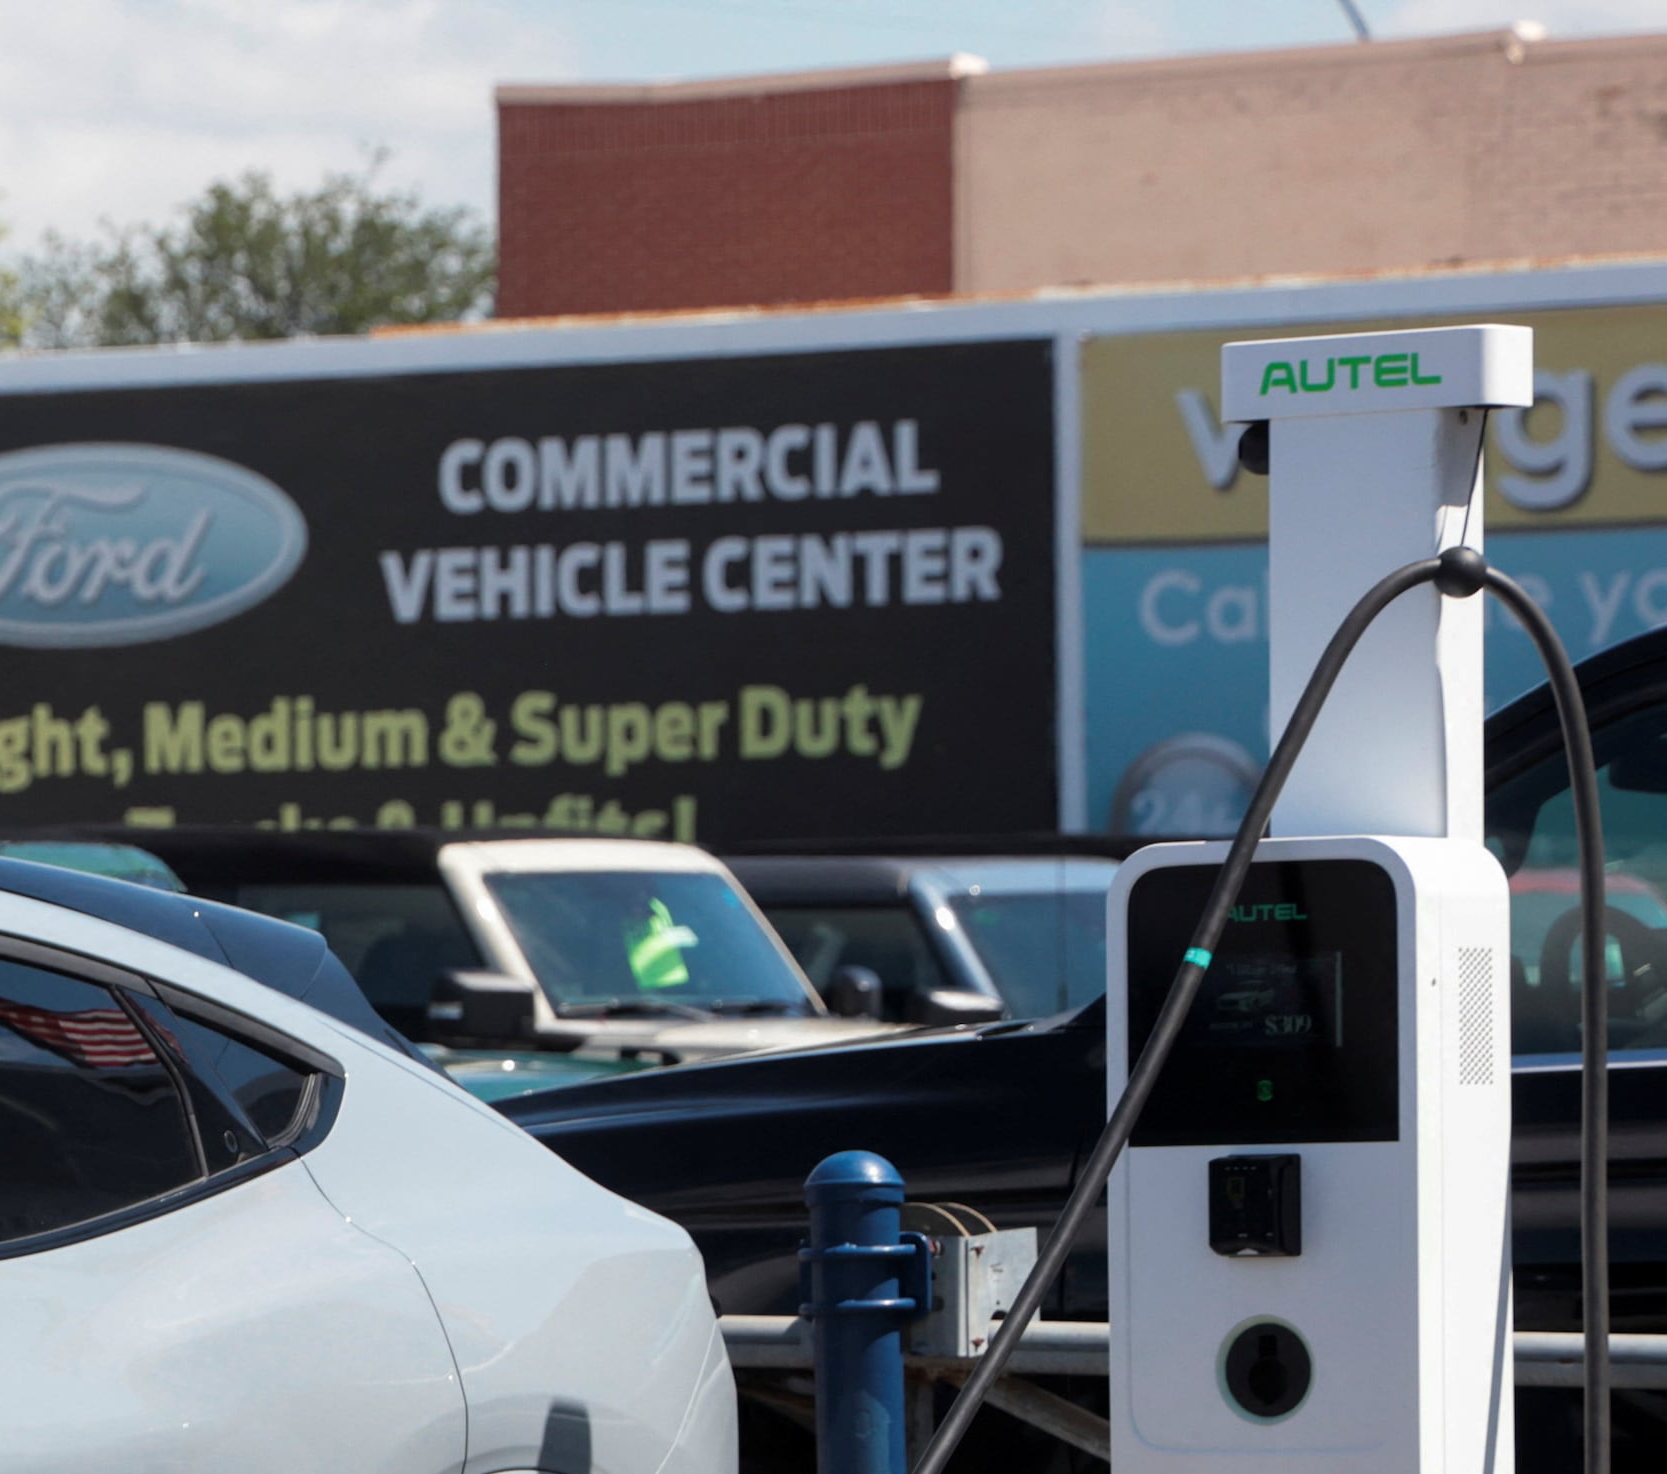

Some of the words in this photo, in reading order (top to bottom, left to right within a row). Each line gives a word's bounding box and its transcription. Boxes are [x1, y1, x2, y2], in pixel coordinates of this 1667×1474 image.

[1259, 353, 1443, 396] AUTEL
[438, 419, 940, 514] COMMERCIAL
[378, 538, 691, 625] VEHICLE
[701, 525, 1005, 614] CENTER
[142, 695, 430, 774] Medium
[438, 691, 498, 768] &
[509, 690, 731, 777] Super
[739, 684, 923, 771] Duty
